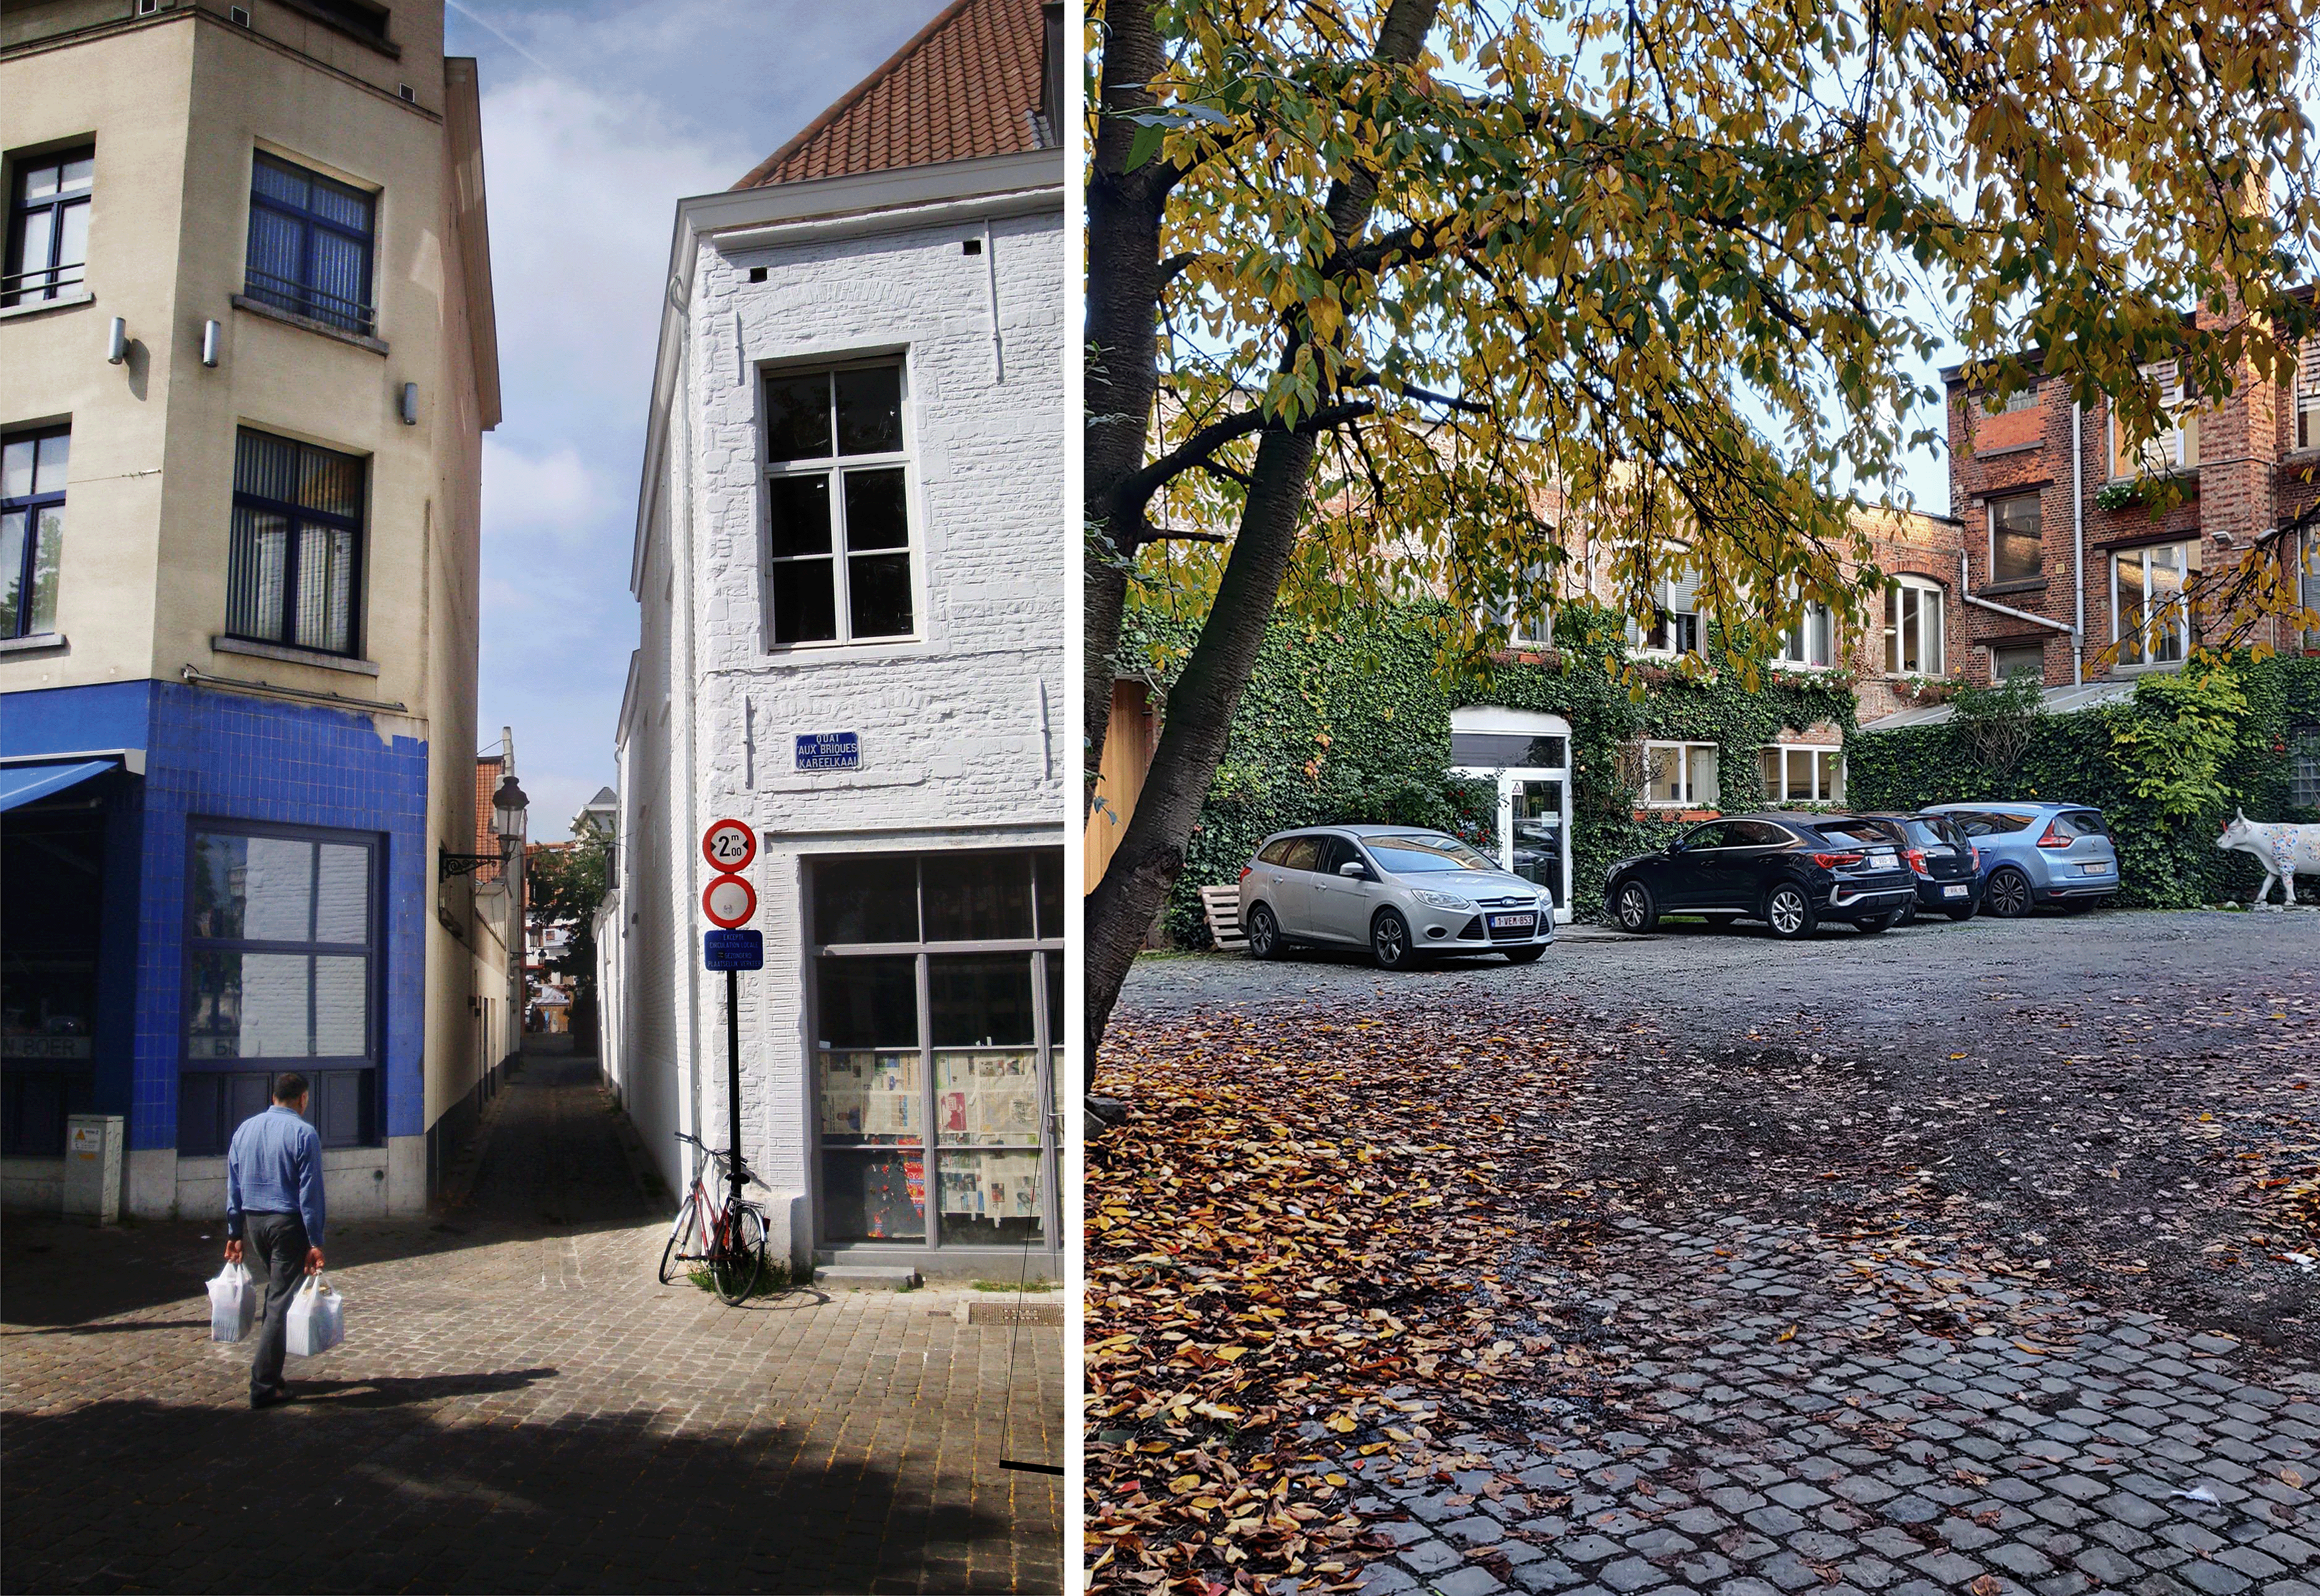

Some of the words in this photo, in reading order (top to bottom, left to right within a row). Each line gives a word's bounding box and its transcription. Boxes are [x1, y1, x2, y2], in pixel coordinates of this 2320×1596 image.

[816, 734, 839, 745] QUAI
[798, 744, 817, 755] AUX
[820, 743, 857, 756] BRIQUES
[799, 756, 857, 769] KAREELKAAI
[23, 1038, 75, 1056] BOER
